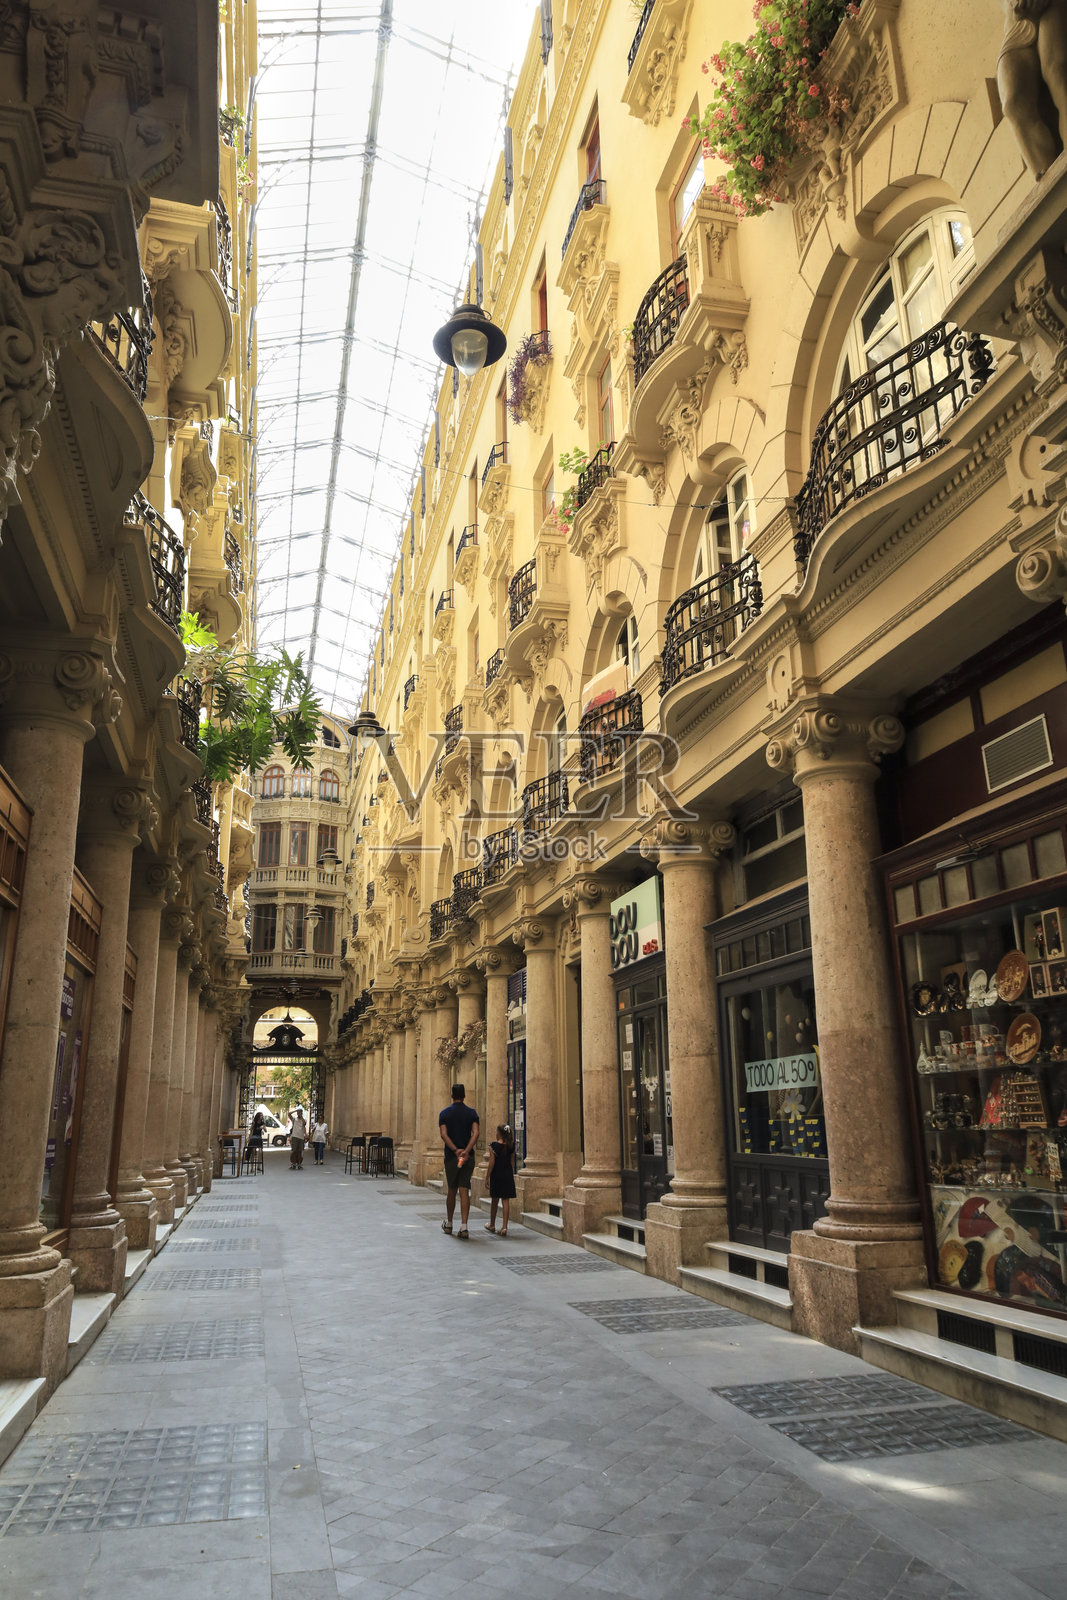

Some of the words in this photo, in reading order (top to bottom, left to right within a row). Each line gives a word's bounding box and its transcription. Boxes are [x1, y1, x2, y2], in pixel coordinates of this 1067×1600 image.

[609, 901, 638, 940] DOU
[610, 931, 639, 968] DOU
[747, 1063, 774, 1087] TODO
[777, 1061, 789, 1085] AL
